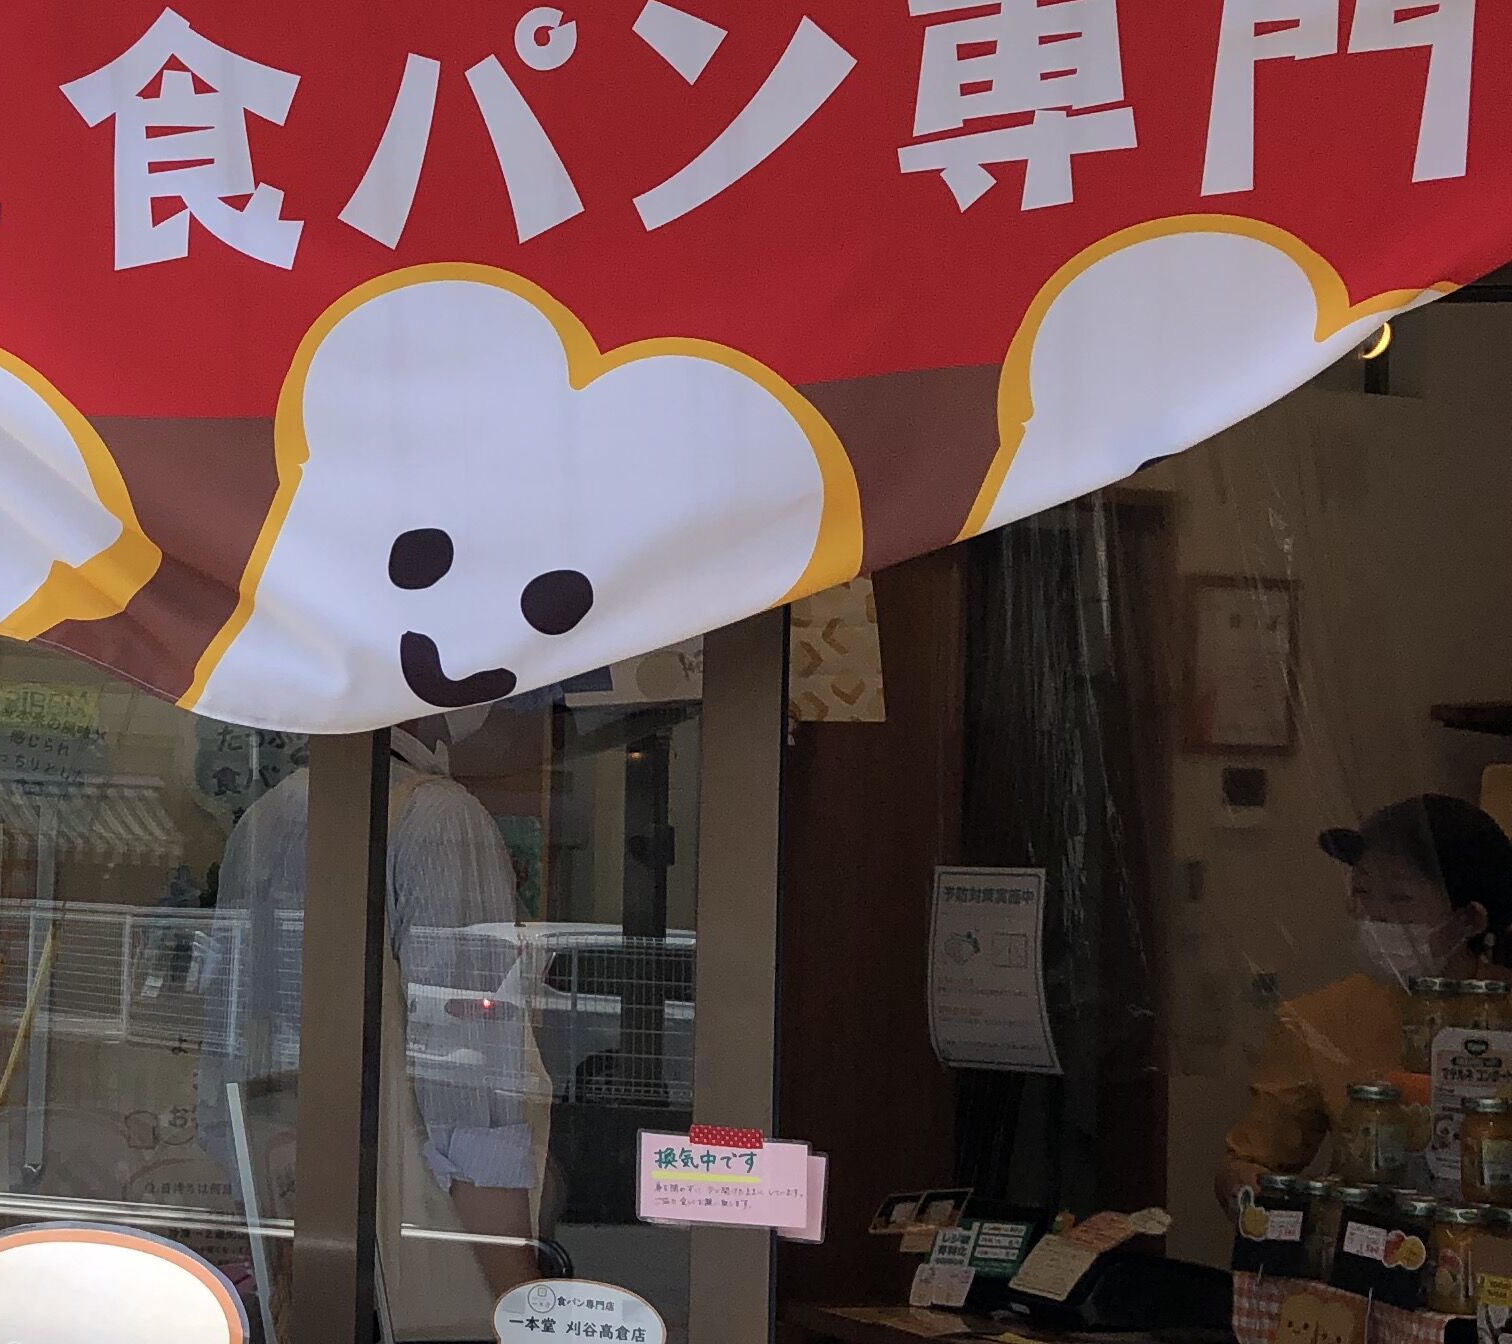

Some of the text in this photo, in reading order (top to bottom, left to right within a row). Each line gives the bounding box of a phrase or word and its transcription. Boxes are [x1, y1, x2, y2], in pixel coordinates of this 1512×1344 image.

[654, 1146, 758, 1174] 換気中です
[557, 1295, 616, 1312] 食パン専門店
[509, 1315, 647, 1343] 一本堂 刈谷高倉店
